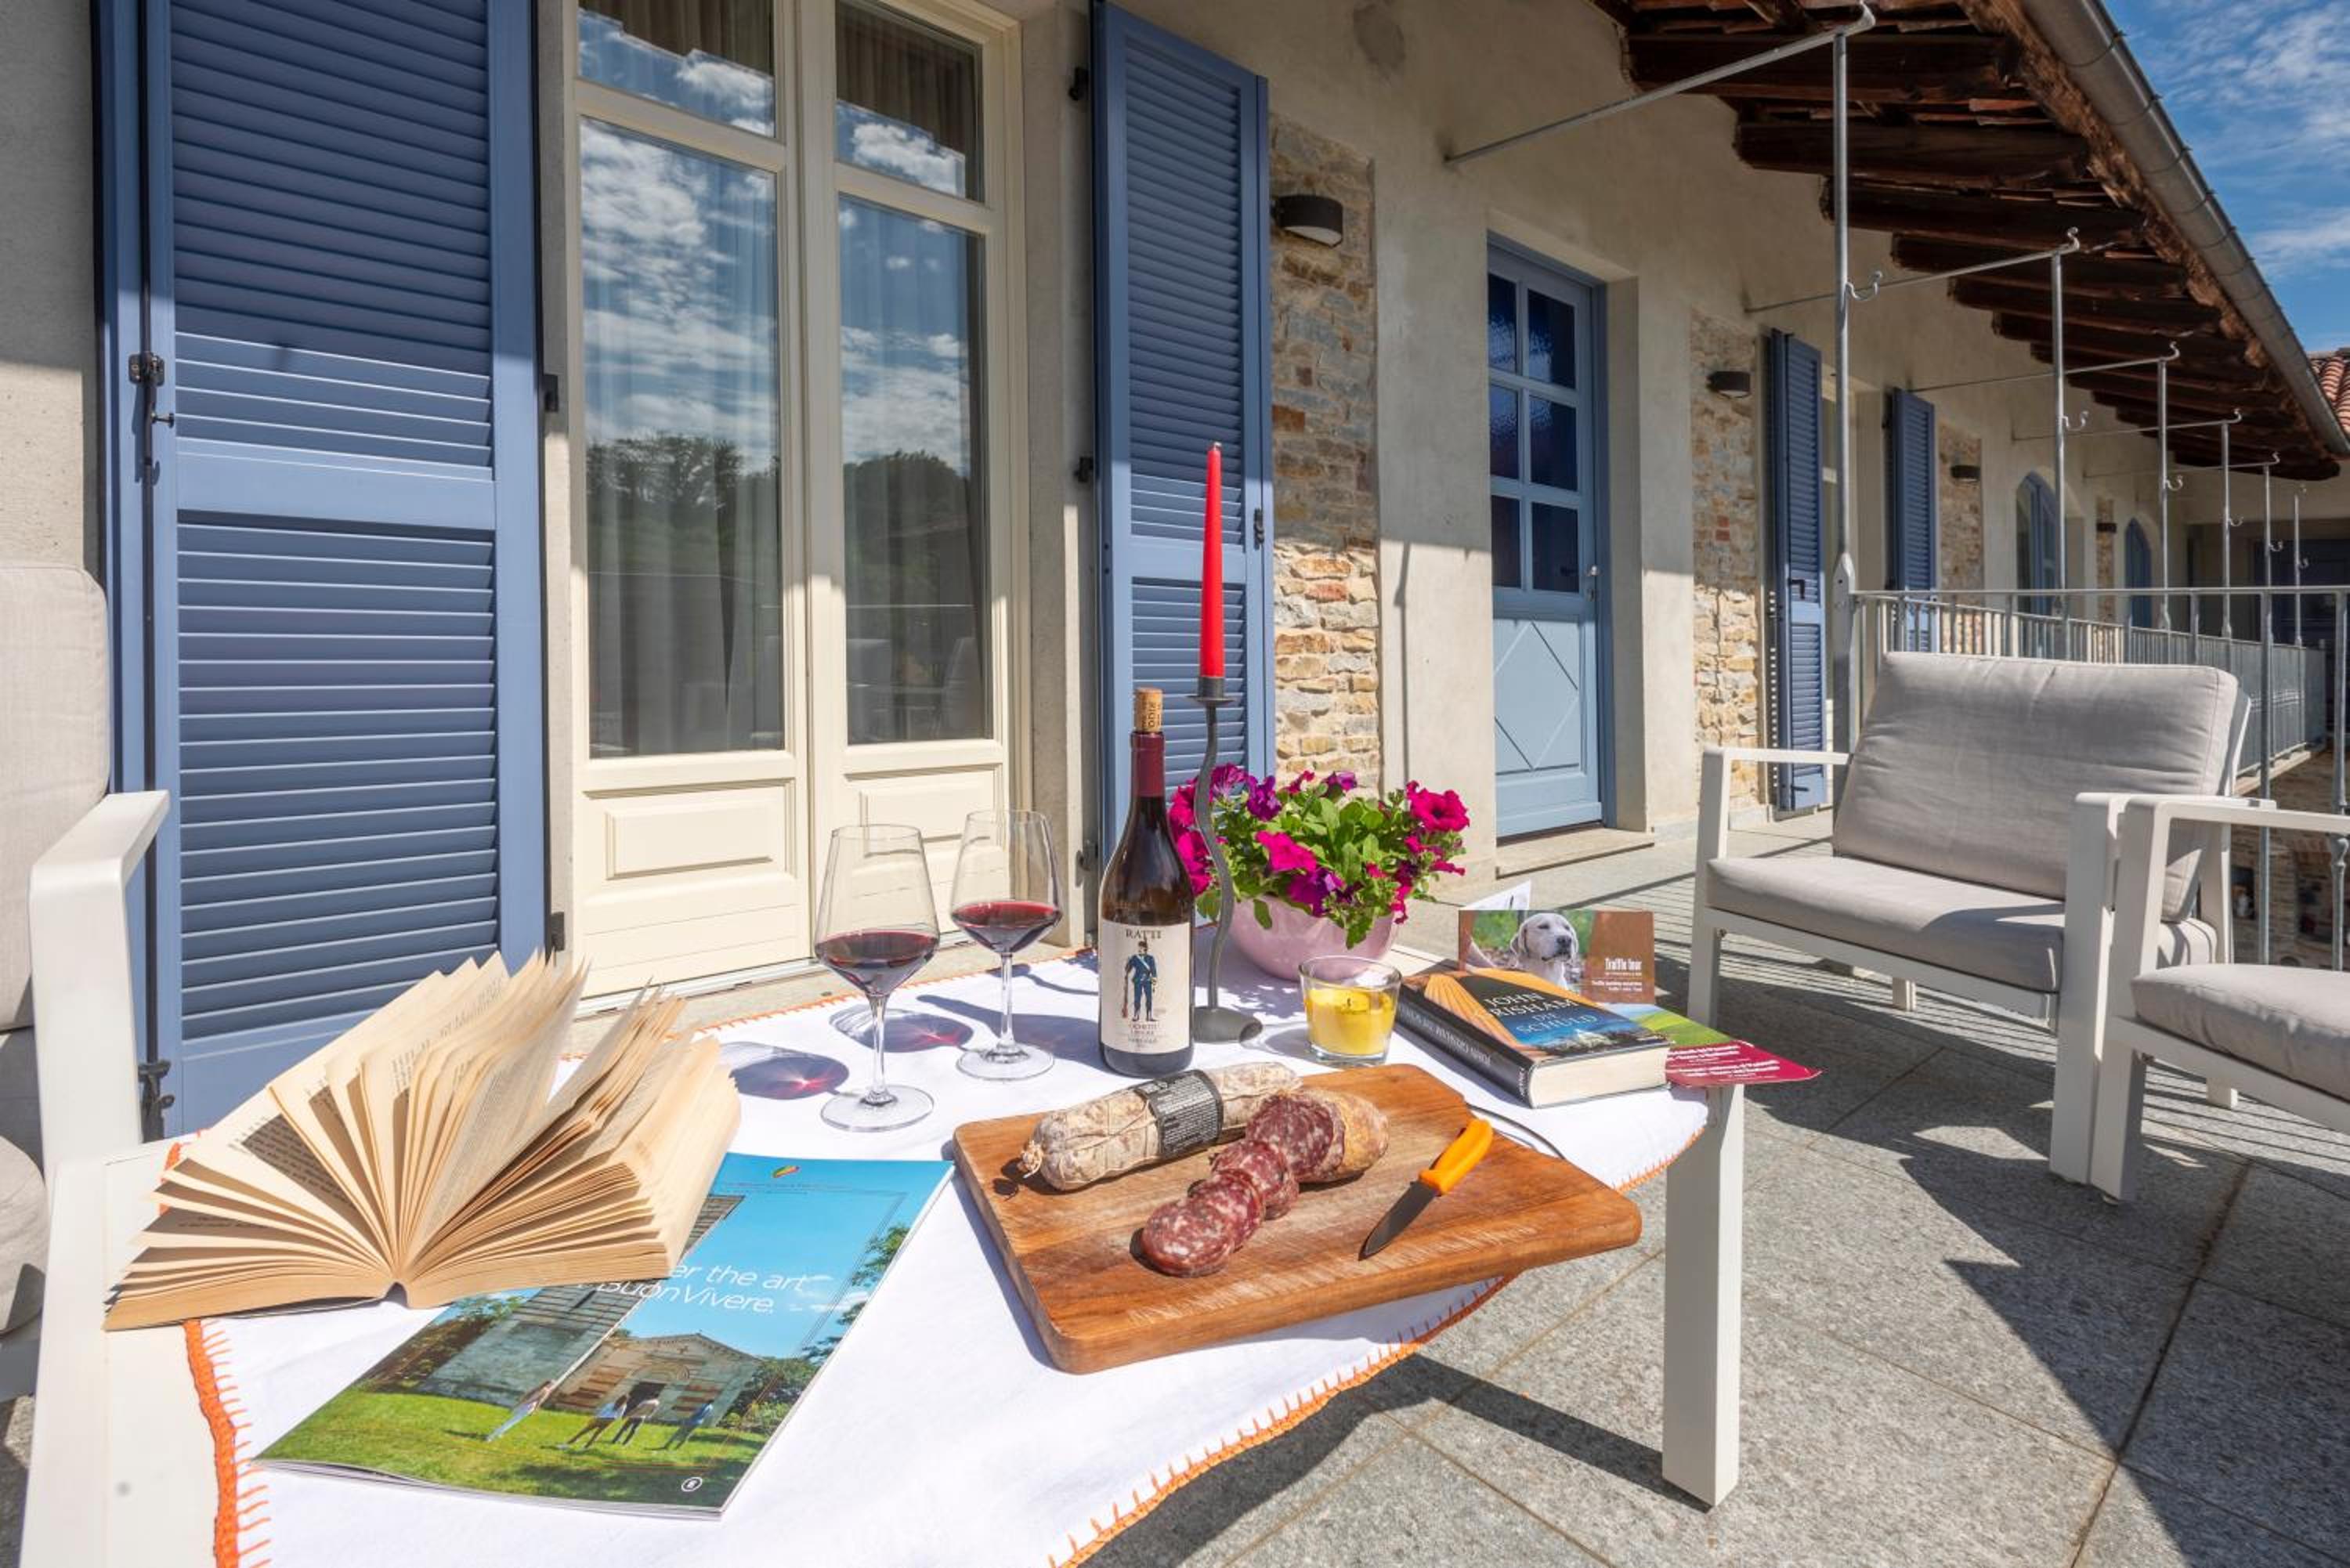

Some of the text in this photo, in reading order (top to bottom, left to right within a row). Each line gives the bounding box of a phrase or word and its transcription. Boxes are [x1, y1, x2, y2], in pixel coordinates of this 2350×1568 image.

[1126, 928, 1162, 939] RATTI
[1483, 992, 1545, 1007] JOHN
[1516, 1014, 1598, 1033] SCHULD
[707, 1265, 758, 1286] the
[762, 1274, 810, 1292] art
